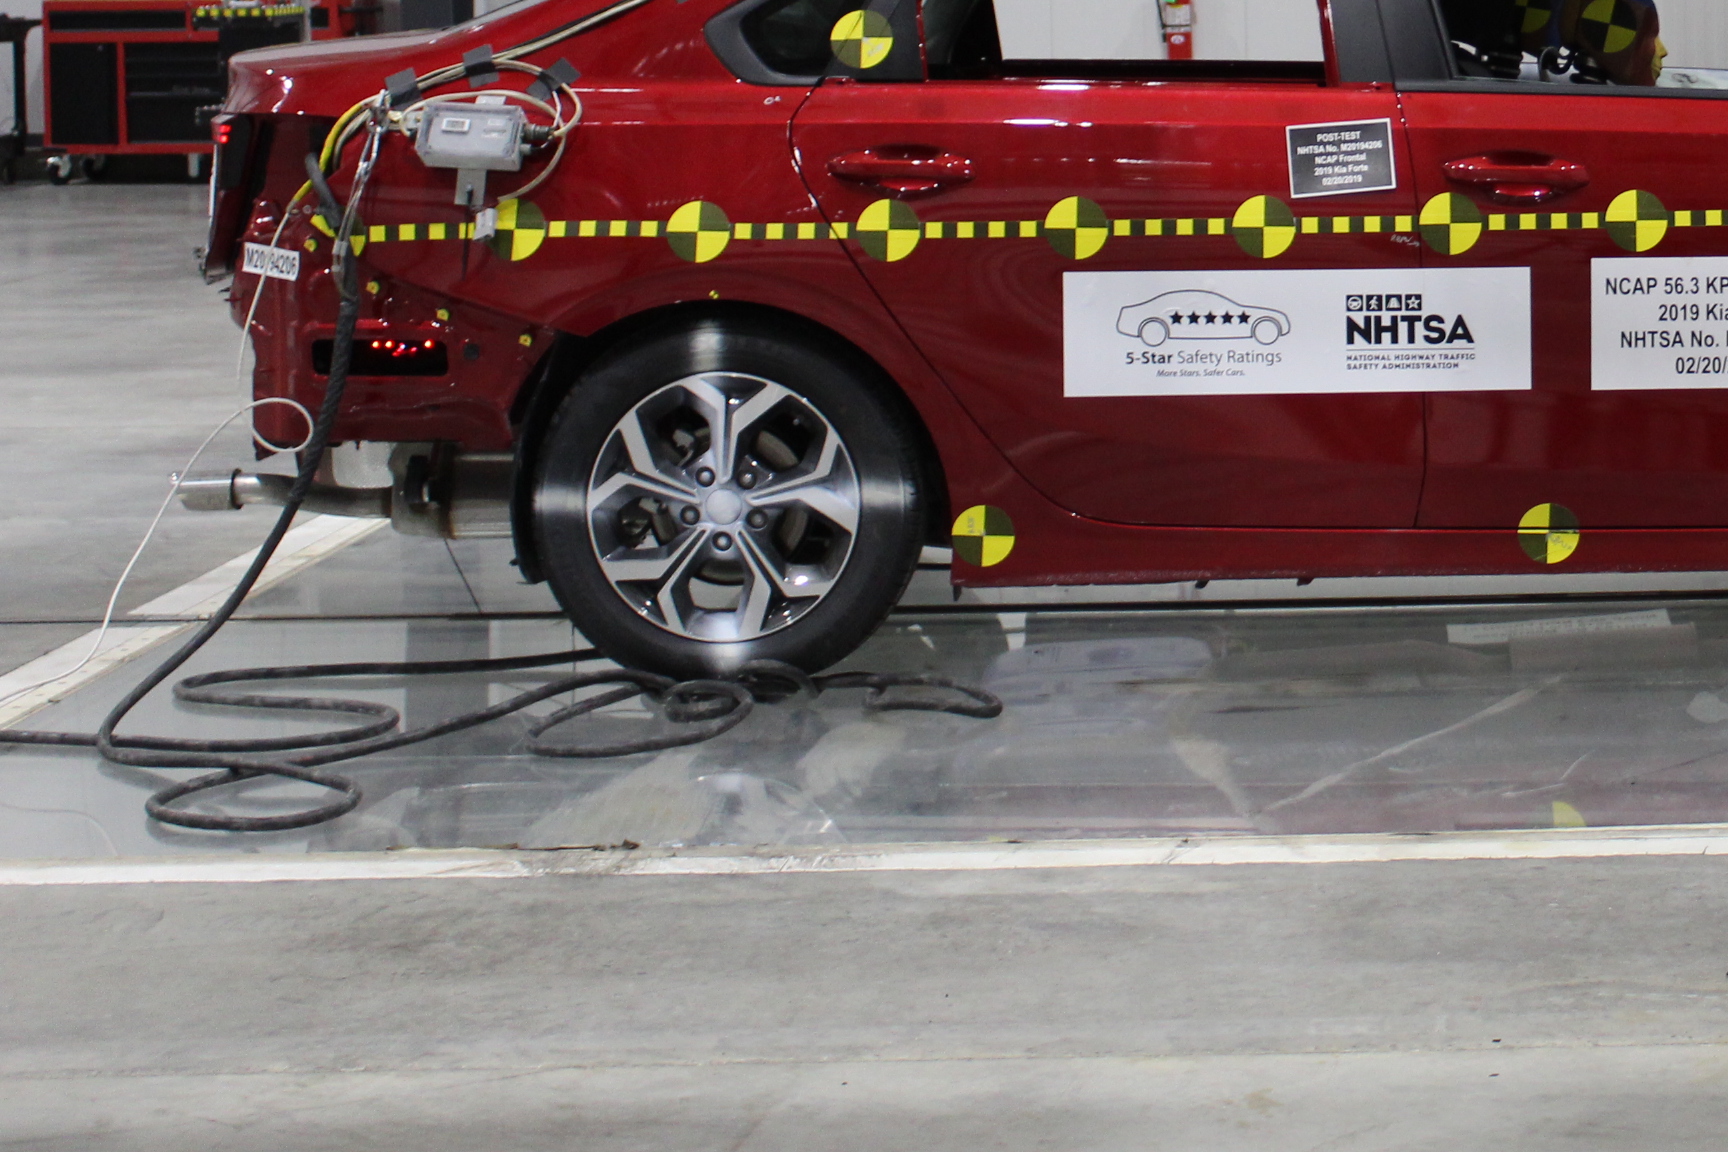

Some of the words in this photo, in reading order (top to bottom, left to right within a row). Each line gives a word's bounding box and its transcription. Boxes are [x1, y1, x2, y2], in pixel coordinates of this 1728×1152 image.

[1316, 131, 1361, 142] POST-TEST
[1297, 145, 1325, 155] NHTSA
[1326, 144, 1339, 153] No.
[1315, 154, 1337, 164] NCAP
[1339, 153, 1366, 163] Frontal
[1314, 166, 1333, 176] 2019
[1334, 164, 1347, 174] Kia
[1348, 164, 1368, 173] Forte
[1322, 175, 1362, 186] 02/20/2019
[246, 248, 297, 276] M2094206
[1605, 277, 1658, 295] NCAP
[1663, 277, 1699, 295] 56.3
[1658, 304, 1699, 321] 2019
[1346, 314, 1475, 345] NHTSA
[1621, 330, 1684, 348] NHTSA
[1691, 330, 1720, 348] No.
[1125, 351, 1174, 365] 5-Star
[1177, 349, 1223, 366] Safety
[1227, 349, 1282, 366] Ratings
[1346, 353, 1391, 361] NATIONAL
[1438, 352, 1476, 360] TRAFFIC
[1382, 362, 1459, 370] ADMINISTRATION
[1156, 369, 1177, 377] More
[1179, 369, 1201, 377] Stars.
[1203, 368, 1224, 376] Safer
[1226, 368, 1245, 376] Cars.
